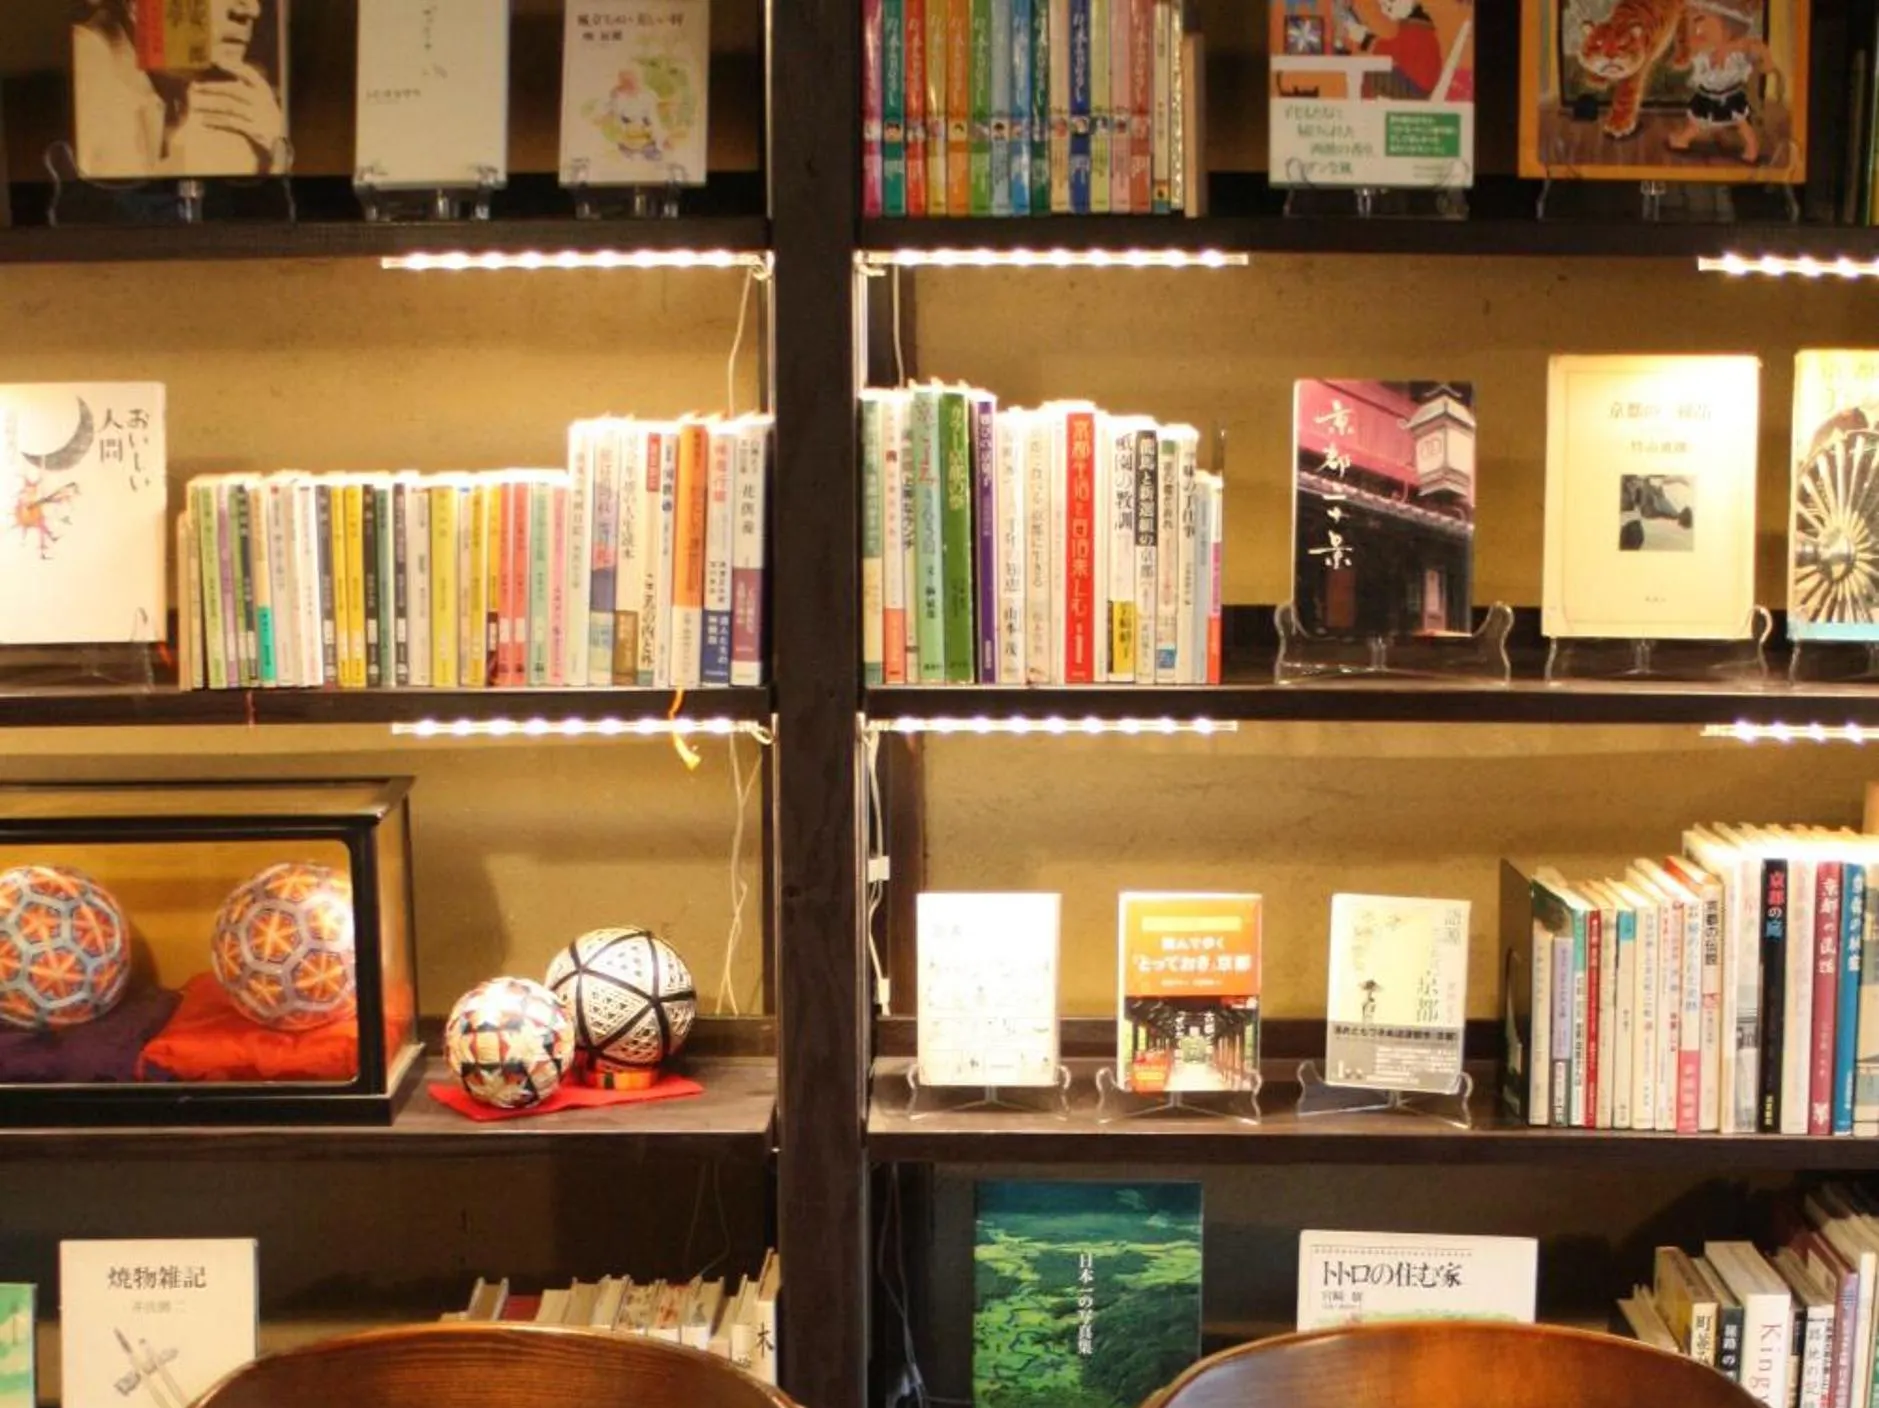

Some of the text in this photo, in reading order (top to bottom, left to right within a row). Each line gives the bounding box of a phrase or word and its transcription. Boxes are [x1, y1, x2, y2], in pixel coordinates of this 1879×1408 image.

[98, 407, 124, 463] 人間
[127, 408, 151, 493] おいしい
[1077, 1251, 1095, 1355] 日本一の写真集
[1323, 1259, 1463, 1288] トトロの住む家
